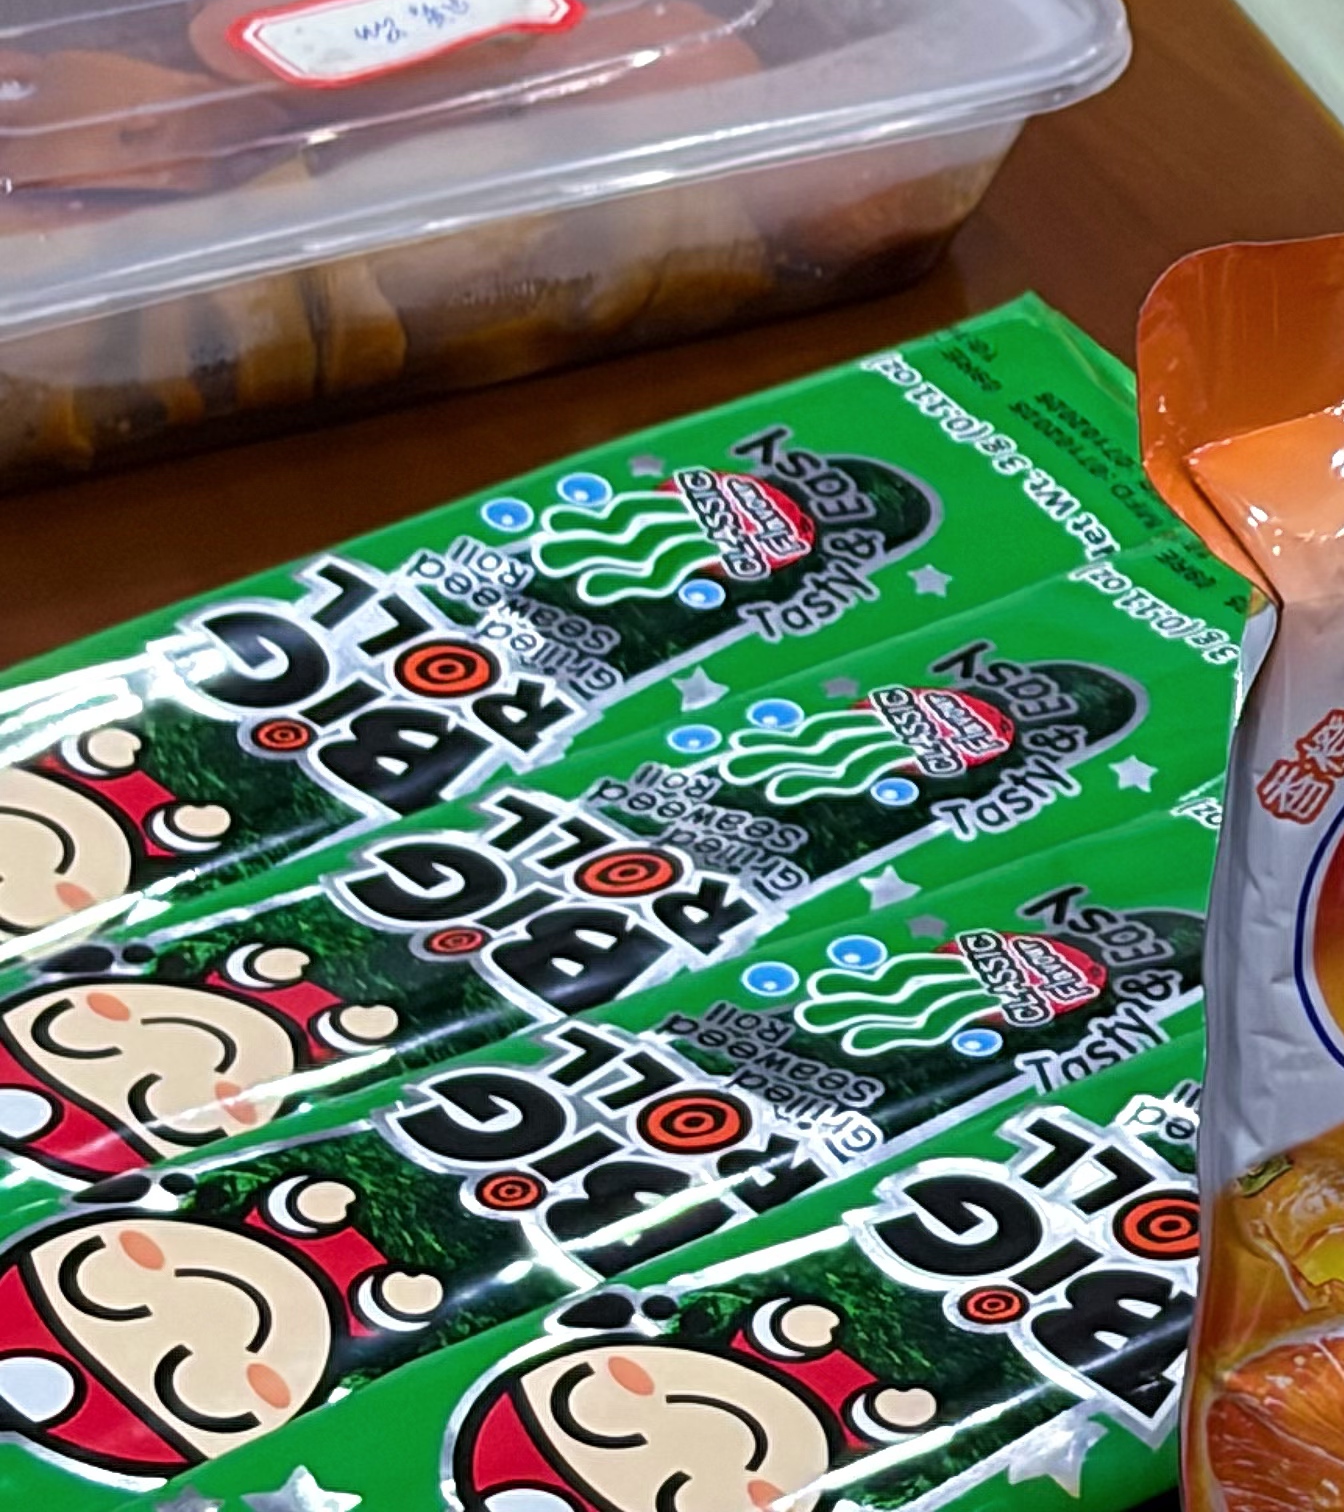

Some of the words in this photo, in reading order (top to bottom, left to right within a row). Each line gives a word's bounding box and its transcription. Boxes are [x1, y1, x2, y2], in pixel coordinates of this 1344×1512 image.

[445, 534, 537, 592] Roll
[673, 465, 772, 582] CLASSIC
[738, 550, 883, 643] Tasty
[310, 560, 582, 752] ROLL
[477, 614, 628, 702] Grilled
[866, 684, 966, 778] CLASSIC
[631, 762, 723, 805] Roll
[932, 753, 1082, 842] Tasty
[488, 792, 760, 957] ROLL
[660, 823, 811, 902] Grilled
[702, 999, 798, 1048] Roll
[955, 928, 1056, 1027] CLASSIC
[1015, 997, 1170, 1096] Tasty
[1017, 1118, 1200, 1262] OLL
